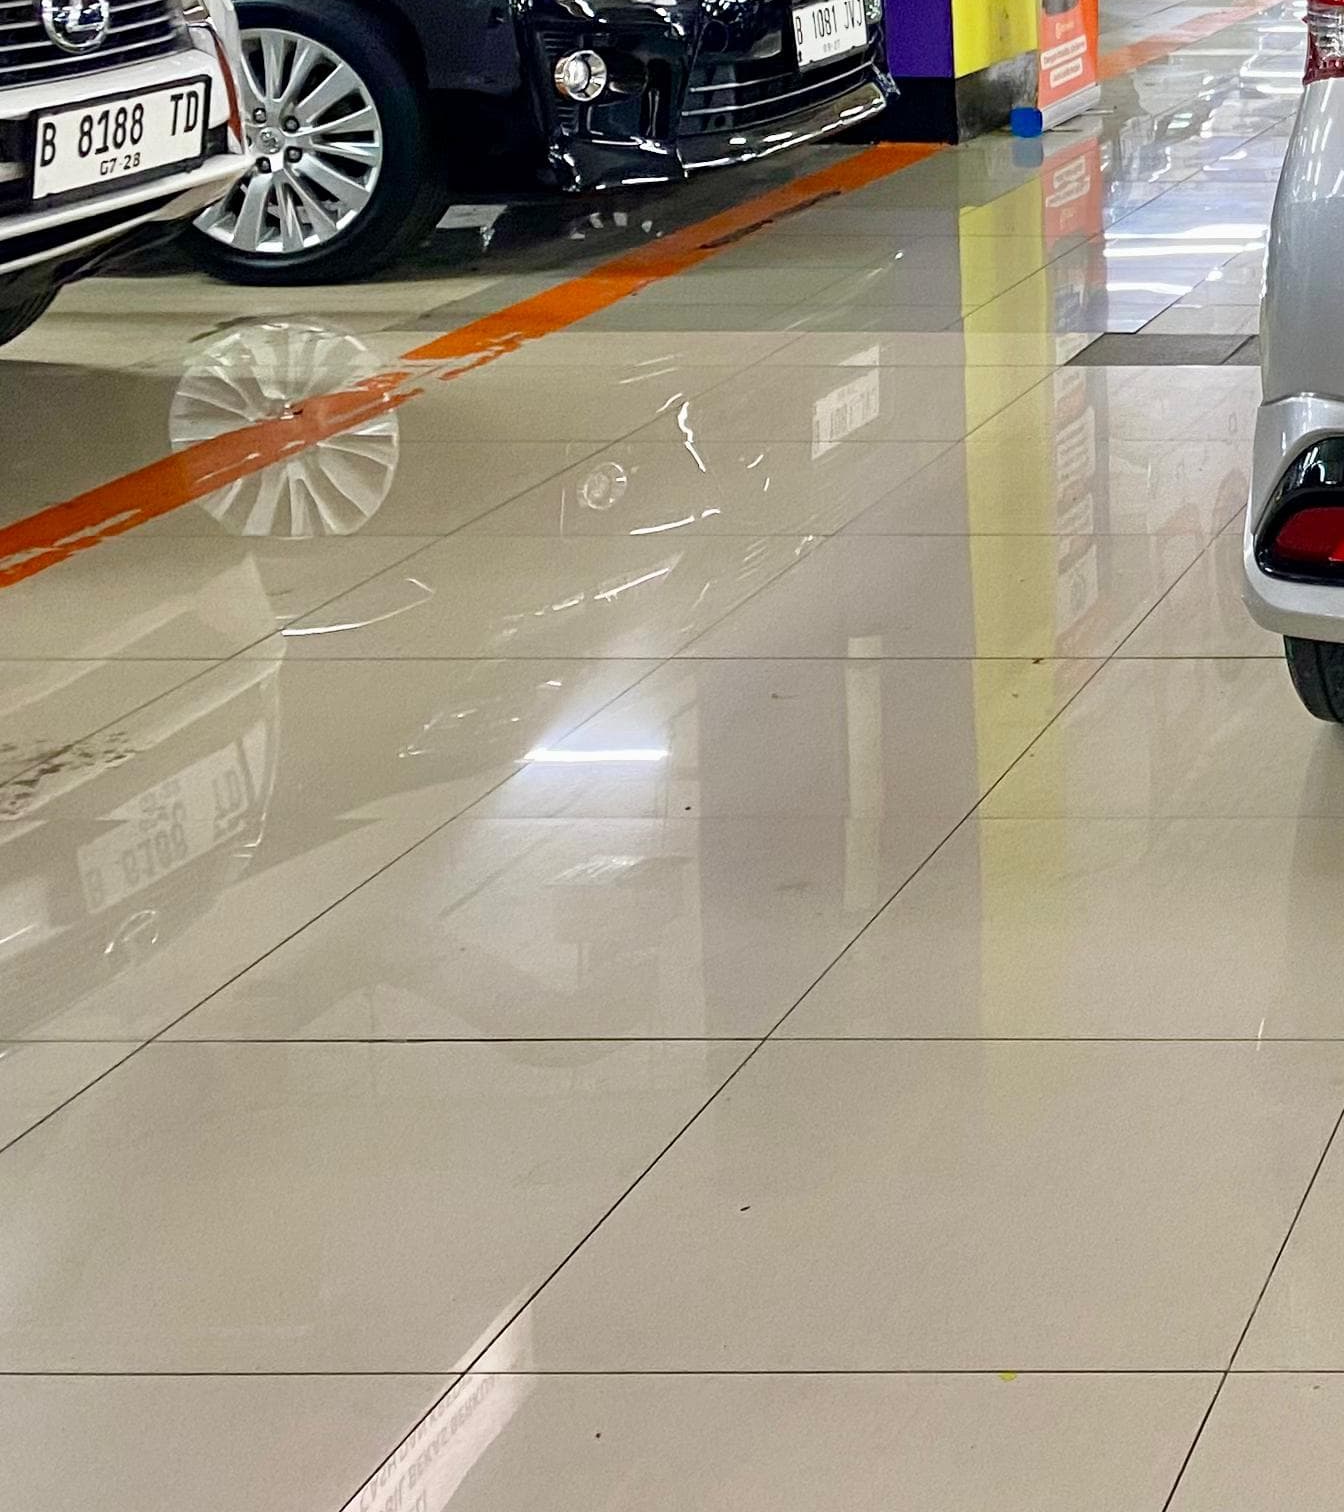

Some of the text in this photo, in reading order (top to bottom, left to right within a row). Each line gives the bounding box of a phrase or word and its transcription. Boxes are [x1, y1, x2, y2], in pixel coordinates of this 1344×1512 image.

[795, 15, 803, 45] B
[812, 4, 838, 39] 1081
[40, 90, 199, 168] B 8188 TD
